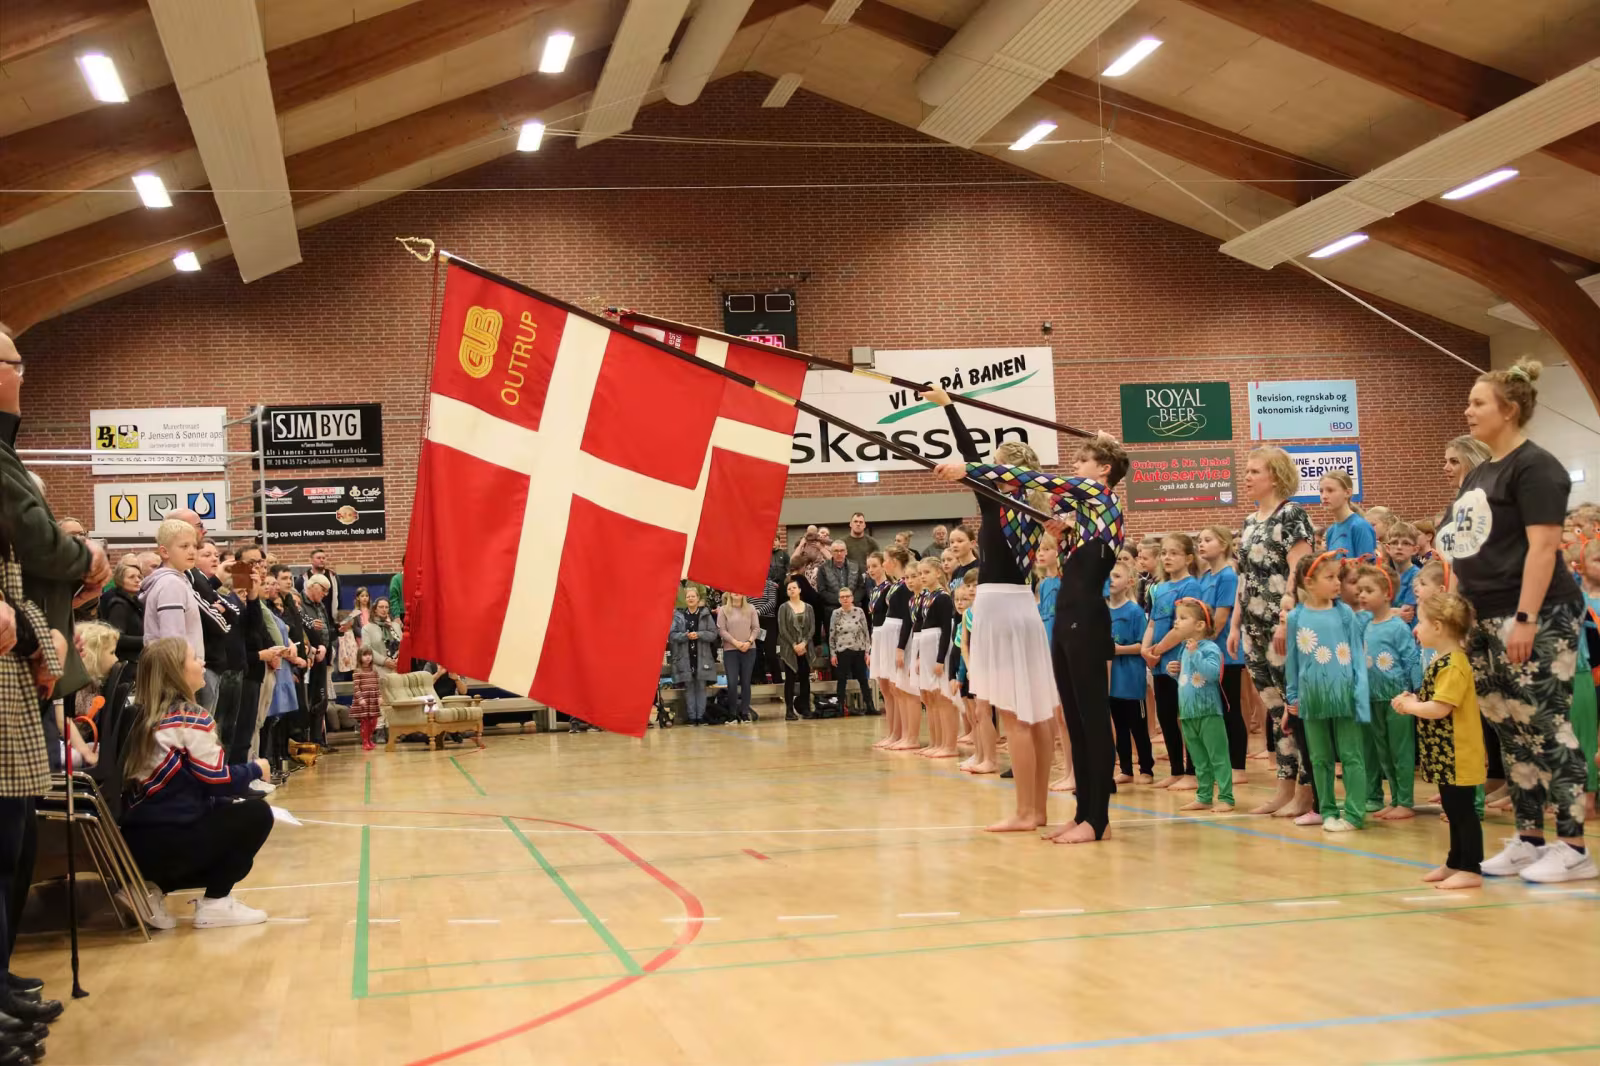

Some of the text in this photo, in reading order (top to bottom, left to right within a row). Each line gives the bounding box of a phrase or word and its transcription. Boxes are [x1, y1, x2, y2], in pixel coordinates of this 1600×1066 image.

[501, 310, 538, 406] OUTRUP
[889, 390, 907, 410] VI
[940, 367, 963, 391] PÅ
[968, 354, 1027, 386] BANEN
[1146, 388, 1206, 408] ROYAL
[1256, 392, 1347, 403] Revision, regnskab og
[1160, 407, 1198, 422] BEER
[1257, 404, 1350, 415] økonomisk rådgivning
[276, 413, 357, 439] SJM BYG
[1332, 421, 1353, 430] BDO
[148, 432, 174, 440] Jensen
[175, 432, 181, 440] &
[183, 431, 208, 440] Sønner
[1171, 458, 1179, 468] &
[1318, 456, 1353, 465] OUTRUP
[1132, 467, 1231, 482] Autoservice
[326, 528, 350, 536] Strand,
